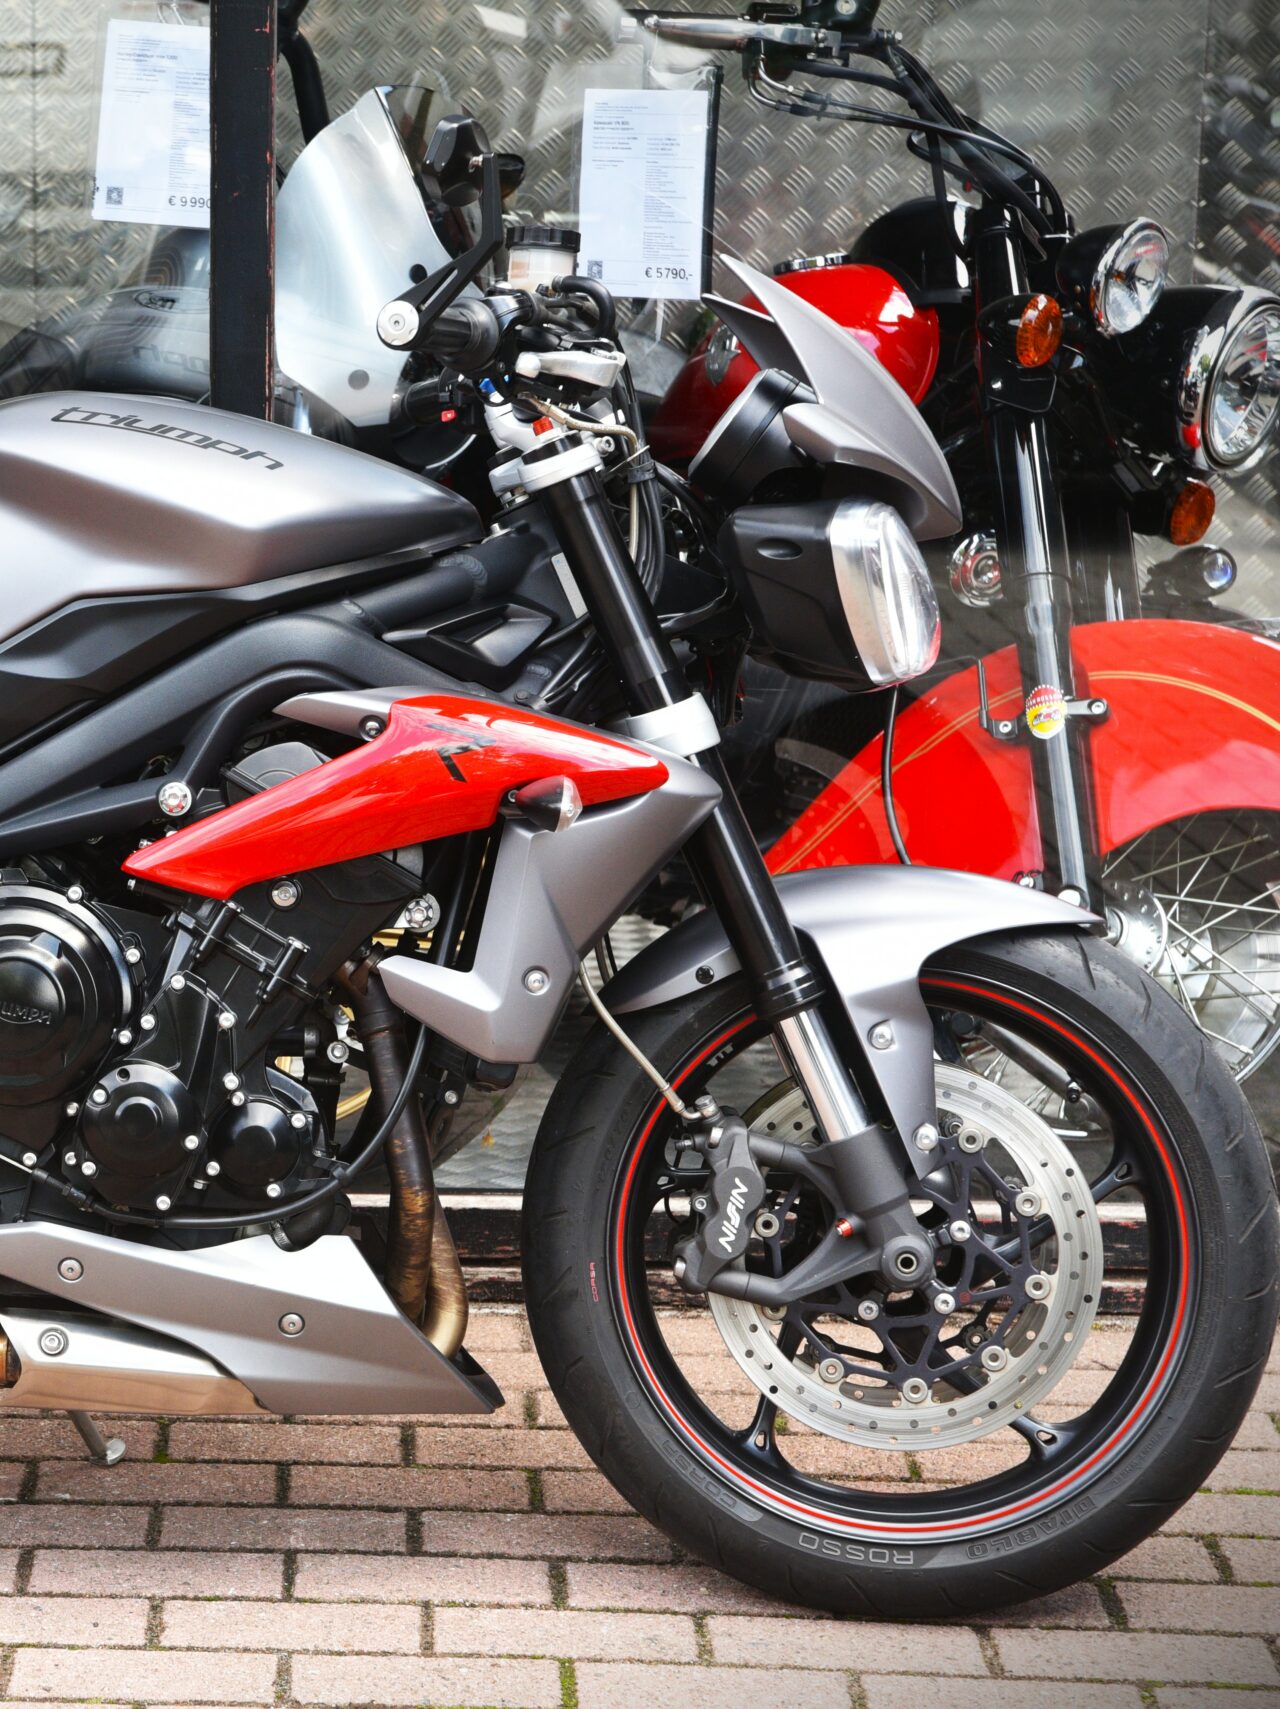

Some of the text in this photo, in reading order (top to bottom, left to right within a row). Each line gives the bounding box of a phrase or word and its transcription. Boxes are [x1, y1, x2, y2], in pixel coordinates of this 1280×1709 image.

[168, 195, 176, 207] €
[644, 266, 652, 278] €
[50, 406, 284, 470] triumph
[966, 1496, 1097, 1560] DIABLO
[798, 1531, 914, 1565] ROSSO
